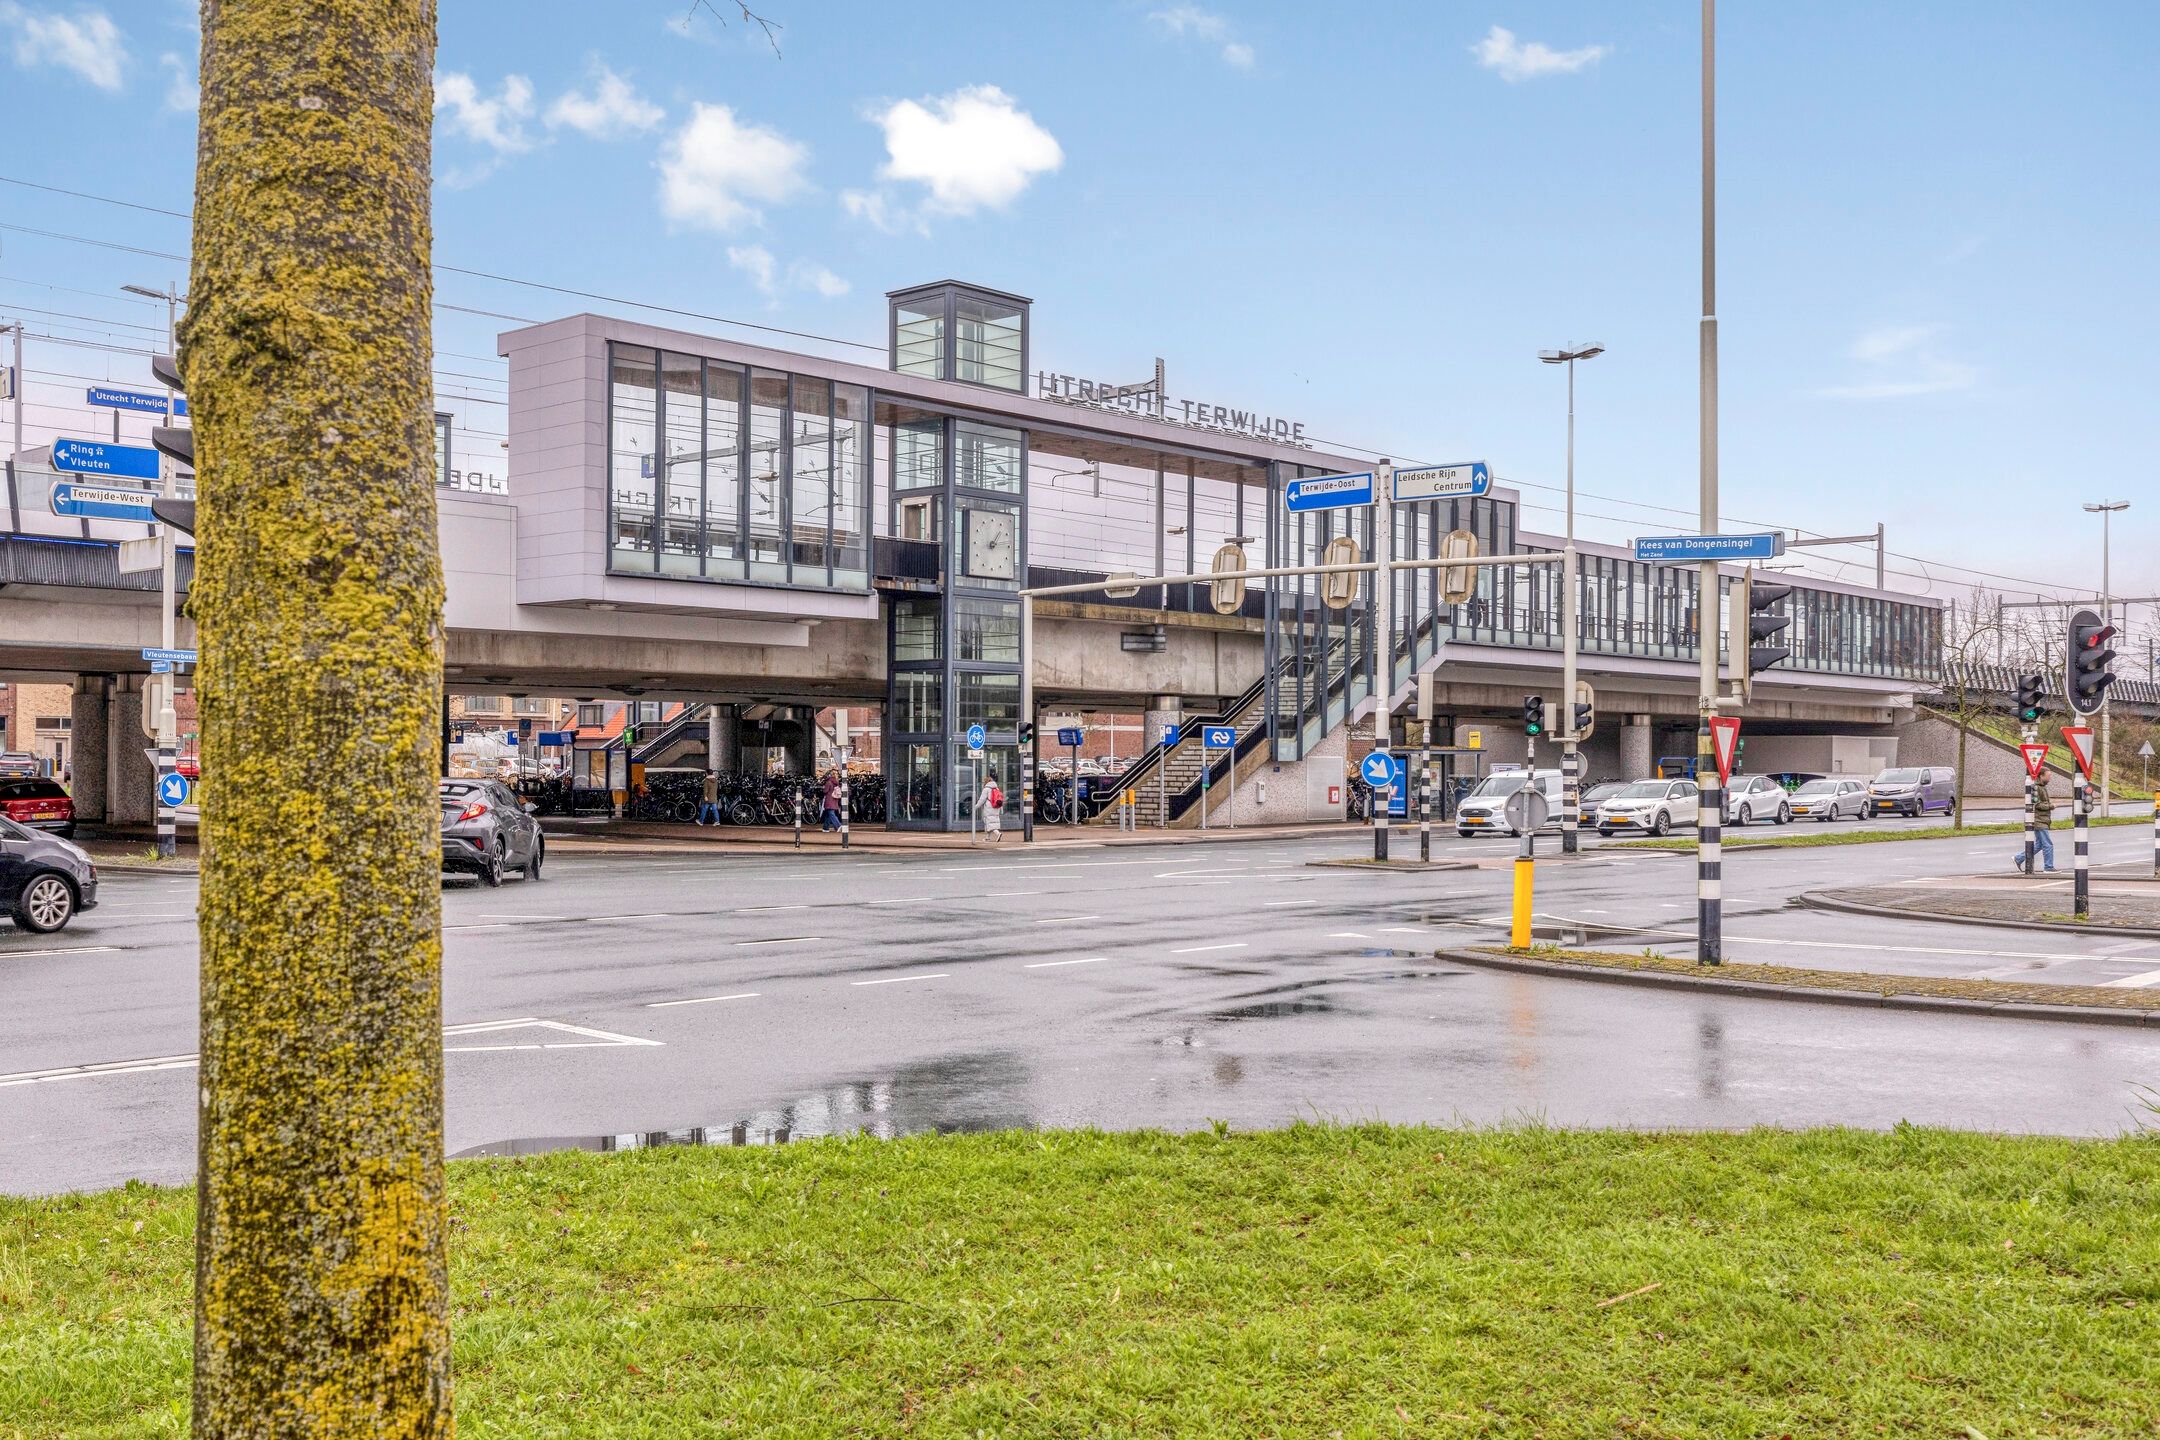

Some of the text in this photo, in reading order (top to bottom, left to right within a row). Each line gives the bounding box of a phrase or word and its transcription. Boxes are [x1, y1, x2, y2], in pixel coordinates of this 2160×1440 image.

[96, 392, 168, 408] Utrecht Terwijde
[1038, 370, 1305, 440] UTRECHT TERWIJDE
[70, 444, 94, 457] Ring
[70, 457, 110, 469] Vleuten
[1398, 469, 1456, 482] Leidsche Rijn
[1300, 480, 1356, 493] Terwijde-Oost
[1434, 481, 1472, 492] Centrum
[72, 488, 144, 503] Terwijde-West
[1640, 538, 1753, 550] Kees van Dongensingel
[146, 651, 197, 660] Vleutensebaan
